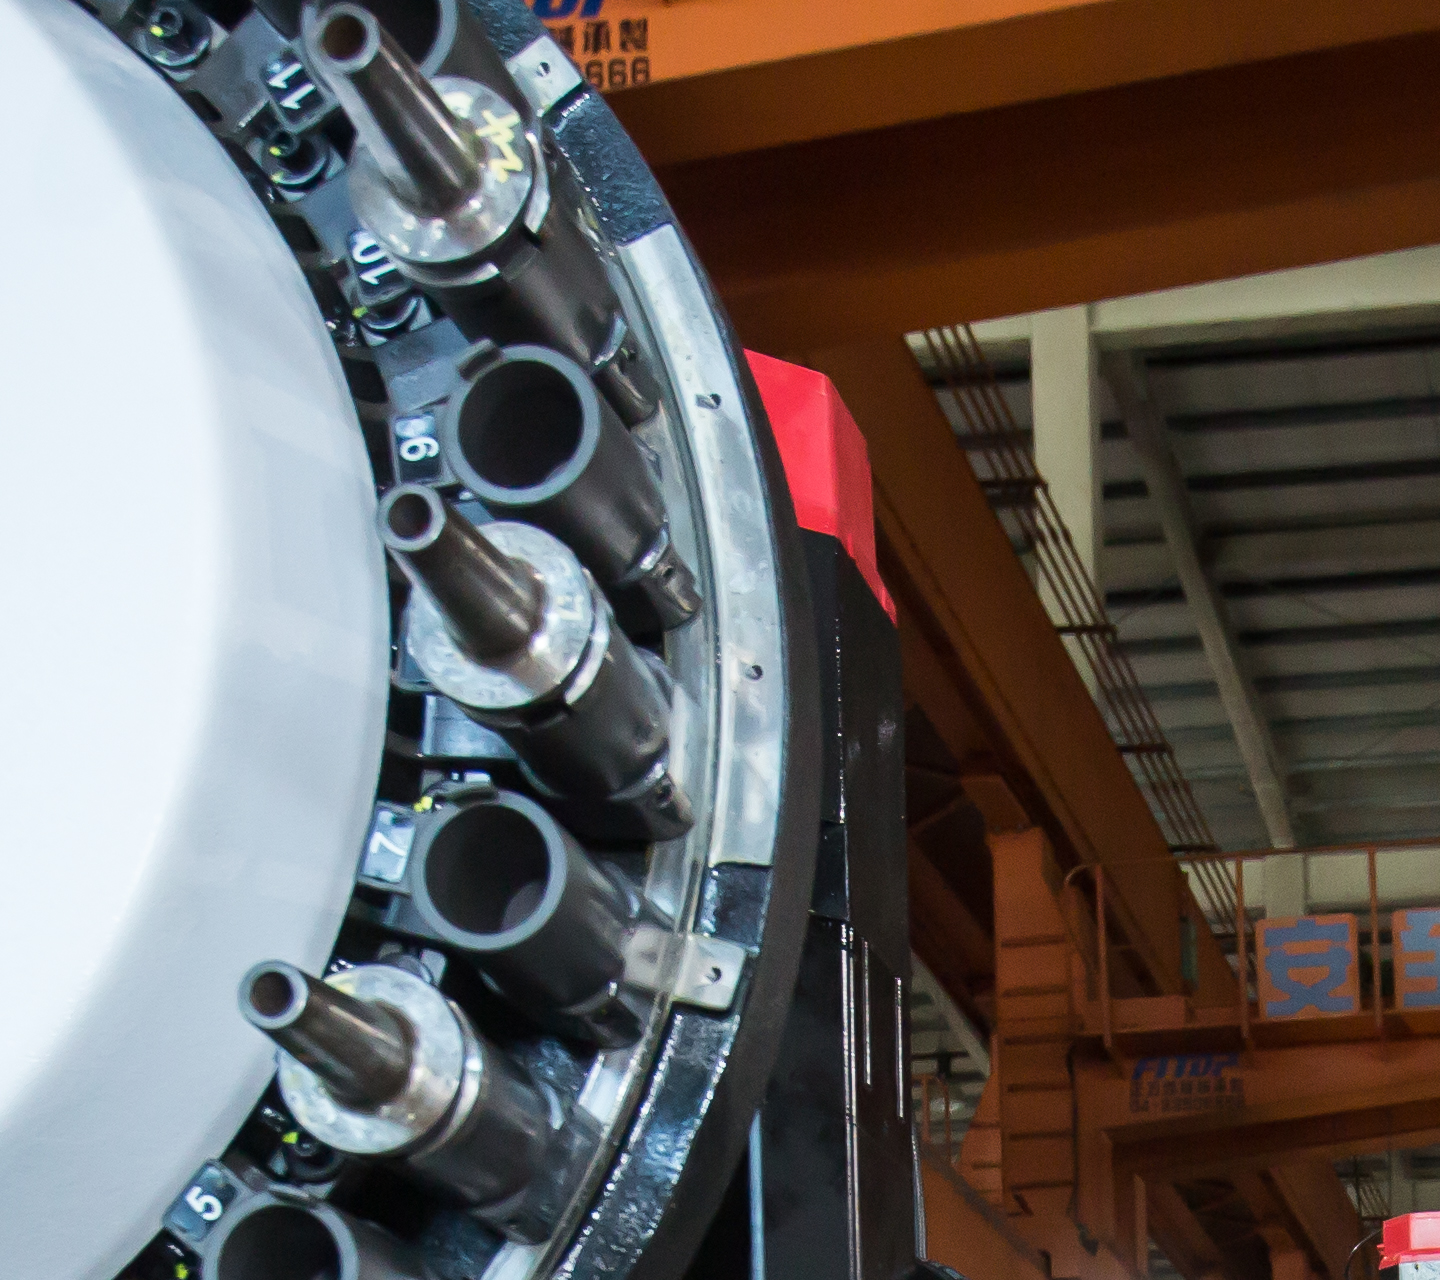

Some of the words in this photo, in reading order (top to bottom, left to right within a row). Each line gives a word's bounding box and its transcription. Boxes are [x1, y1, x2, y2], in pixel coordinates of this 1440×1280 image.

[268, 62, 317, 110] 11
[369, 831, 408, 858] 7
[186, 1185, 224, 1222] 5
